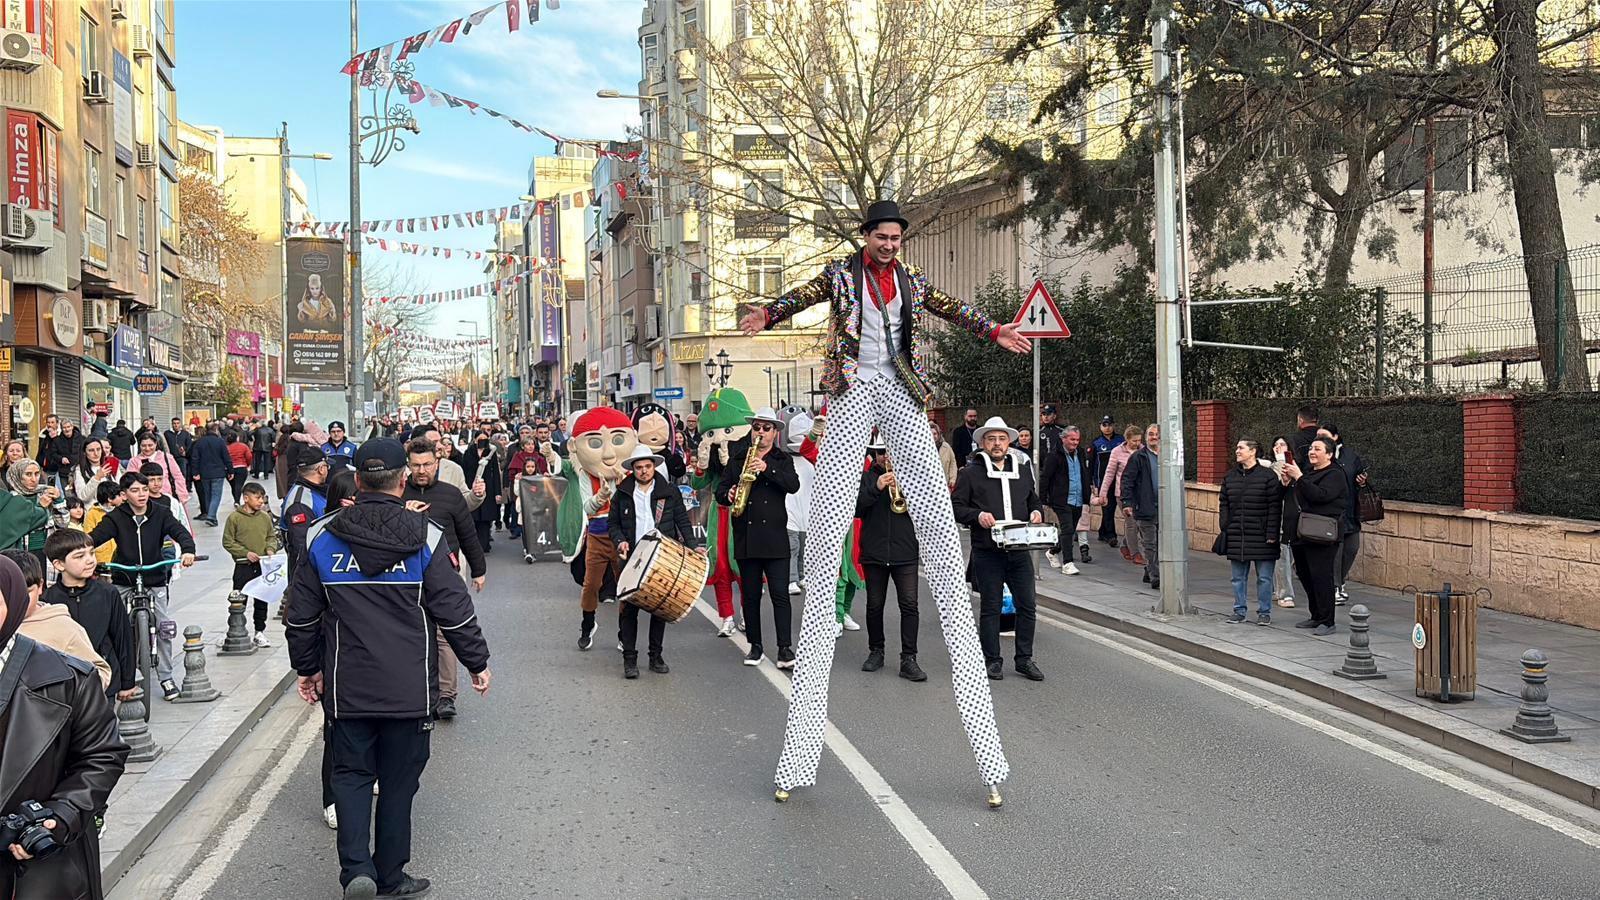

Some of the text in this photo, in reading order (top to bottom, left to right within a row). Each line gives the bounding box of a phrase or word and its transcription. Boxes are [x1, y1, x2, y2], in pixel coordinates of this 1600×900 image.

[13, 123, 31, 208] e-imza
[671, 342, 706, 361] LİZAY
[536, 531, 552, 545] 4.
